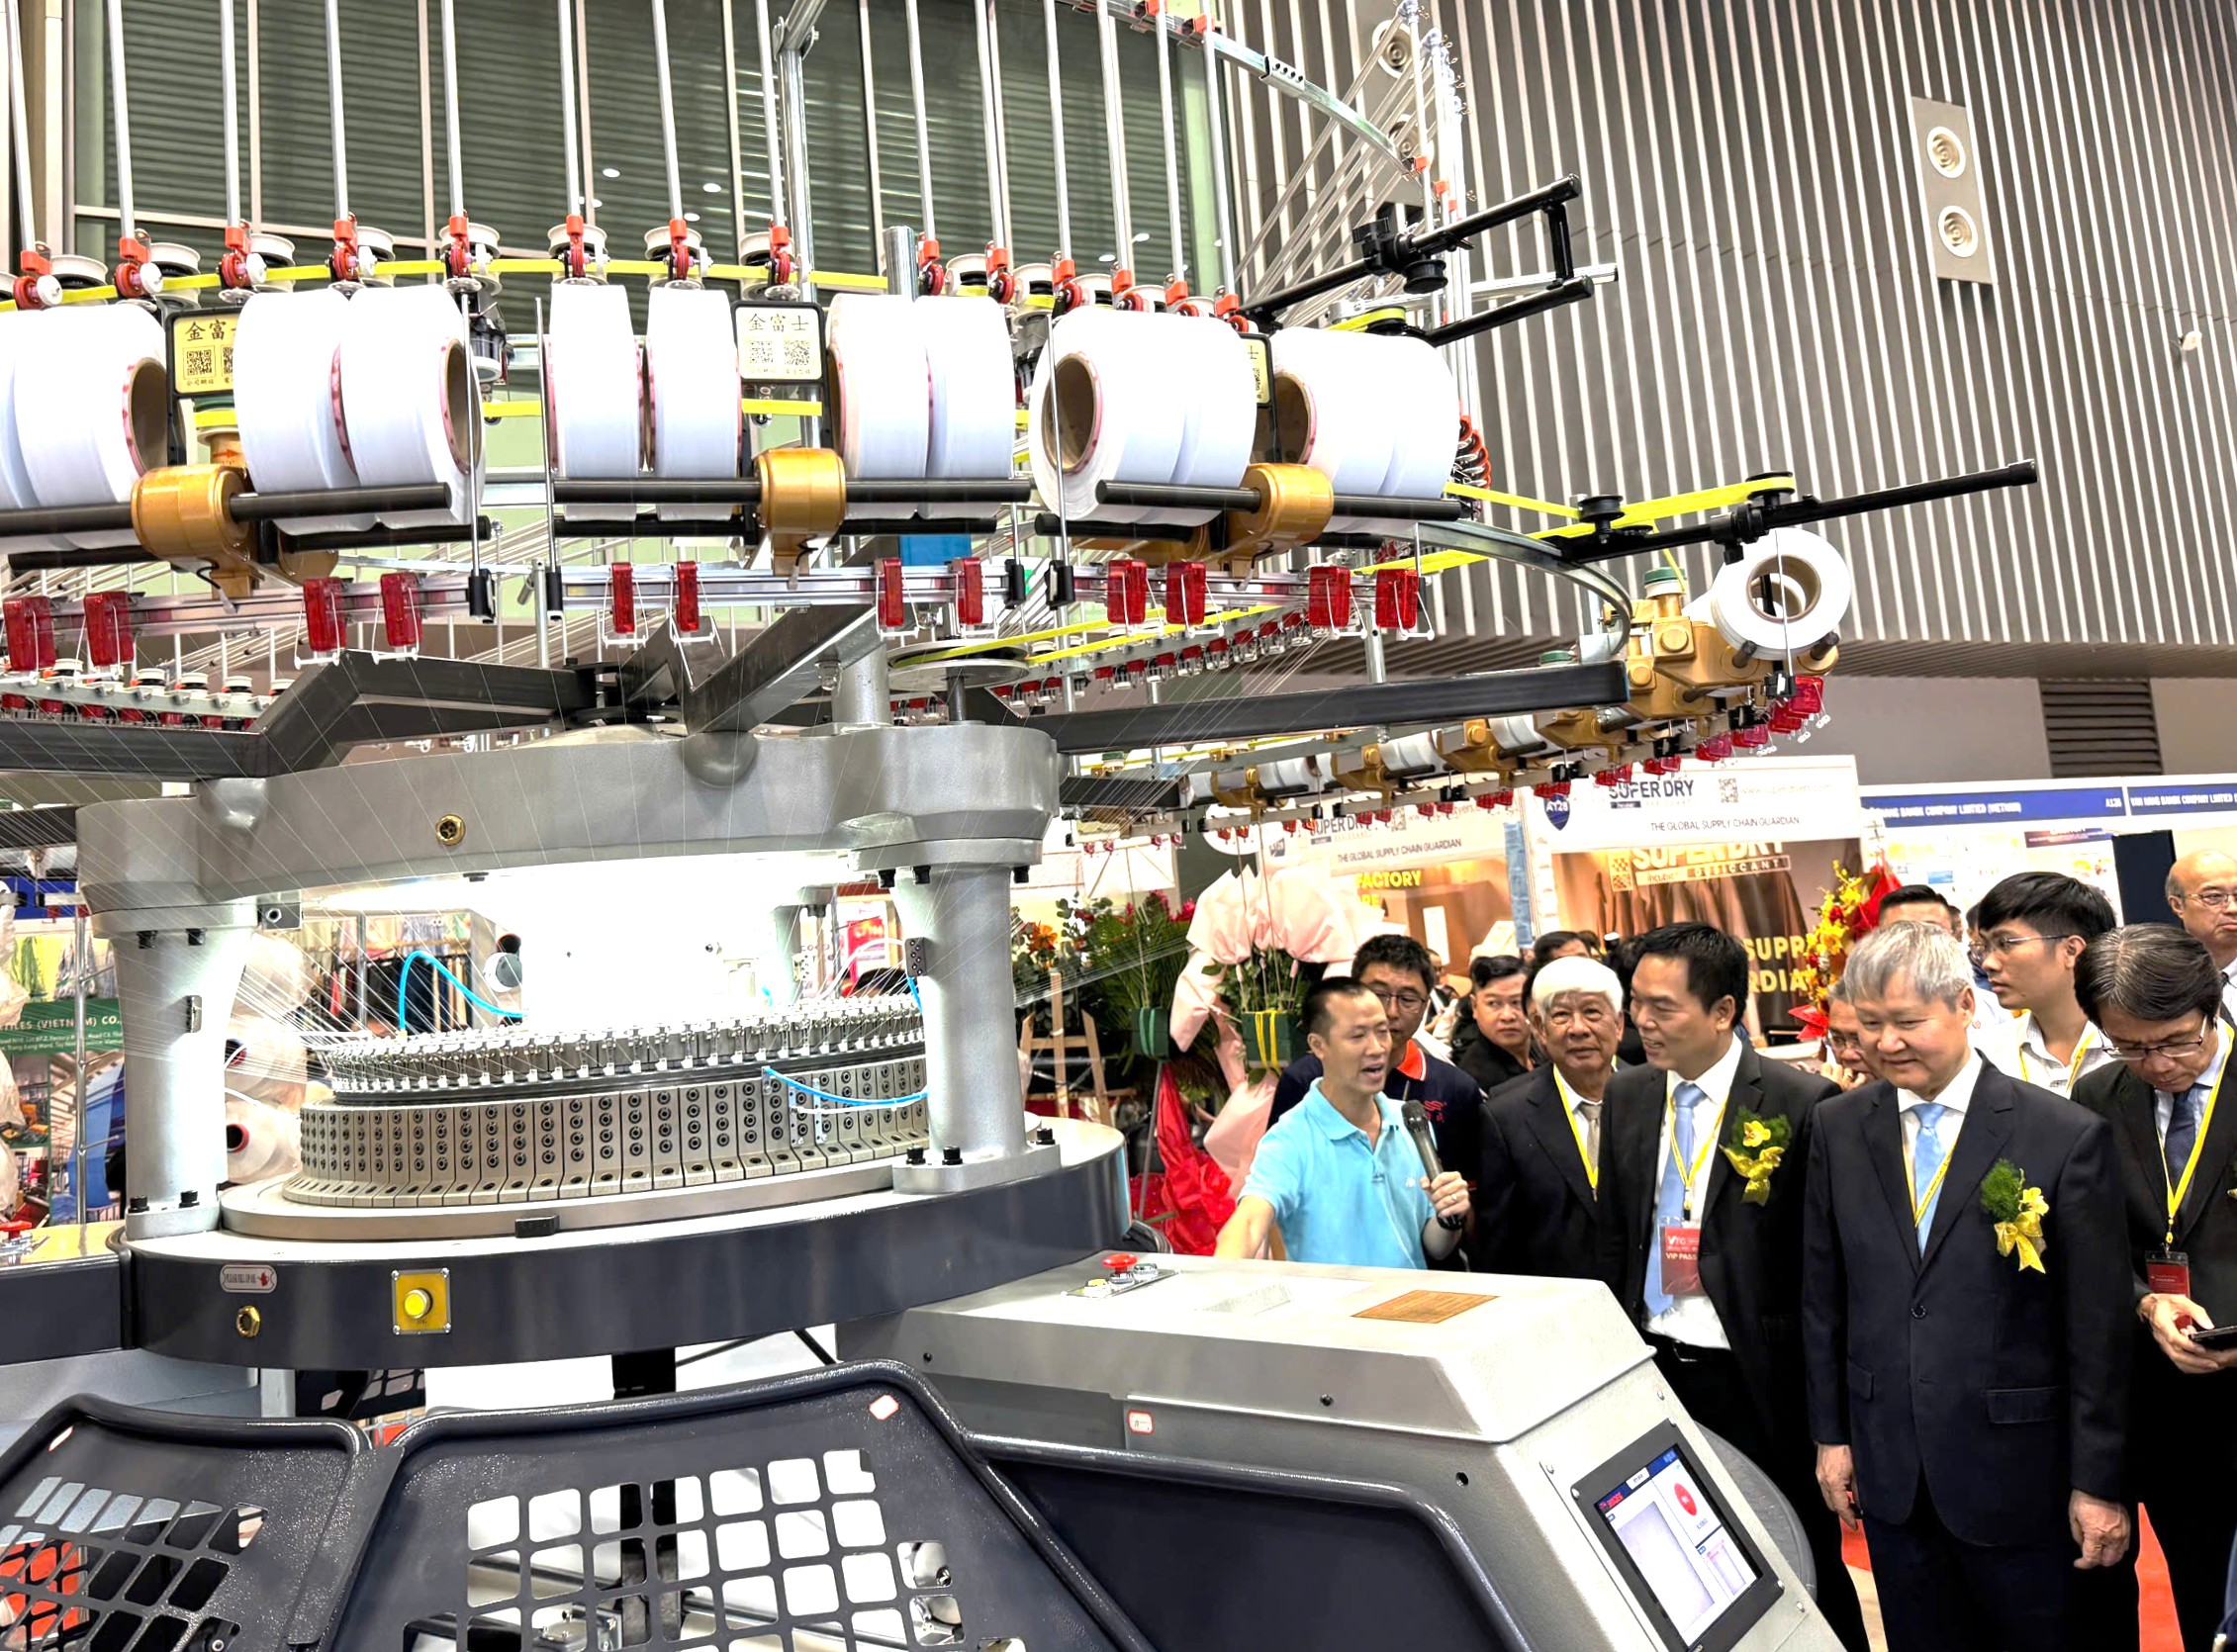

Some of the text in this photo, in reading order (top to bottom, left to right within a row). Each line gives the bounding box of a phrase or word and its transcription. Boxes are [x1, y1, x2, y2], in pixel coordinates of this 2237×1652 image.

[184, 320, 236, 341] 金富
[748, 313, 809, 332] 金富士
[1663, 780, 1694, 797] DRY
[1650, 816, 1800, 832] THE GLOBAL SUPPLY CHAIN GUARDIAN
[1338, 838, 1462, 864] THE GLOBAL SUPPLY CHAIN GUARDIAN
[1631, 844, 1726, 871] SUPER
[1694, 859, 1779, 878] DESICCANT
[1356, 870, 1422, 889] FACTORY
[37, 1017, 97, 1030] (VIETNM)
